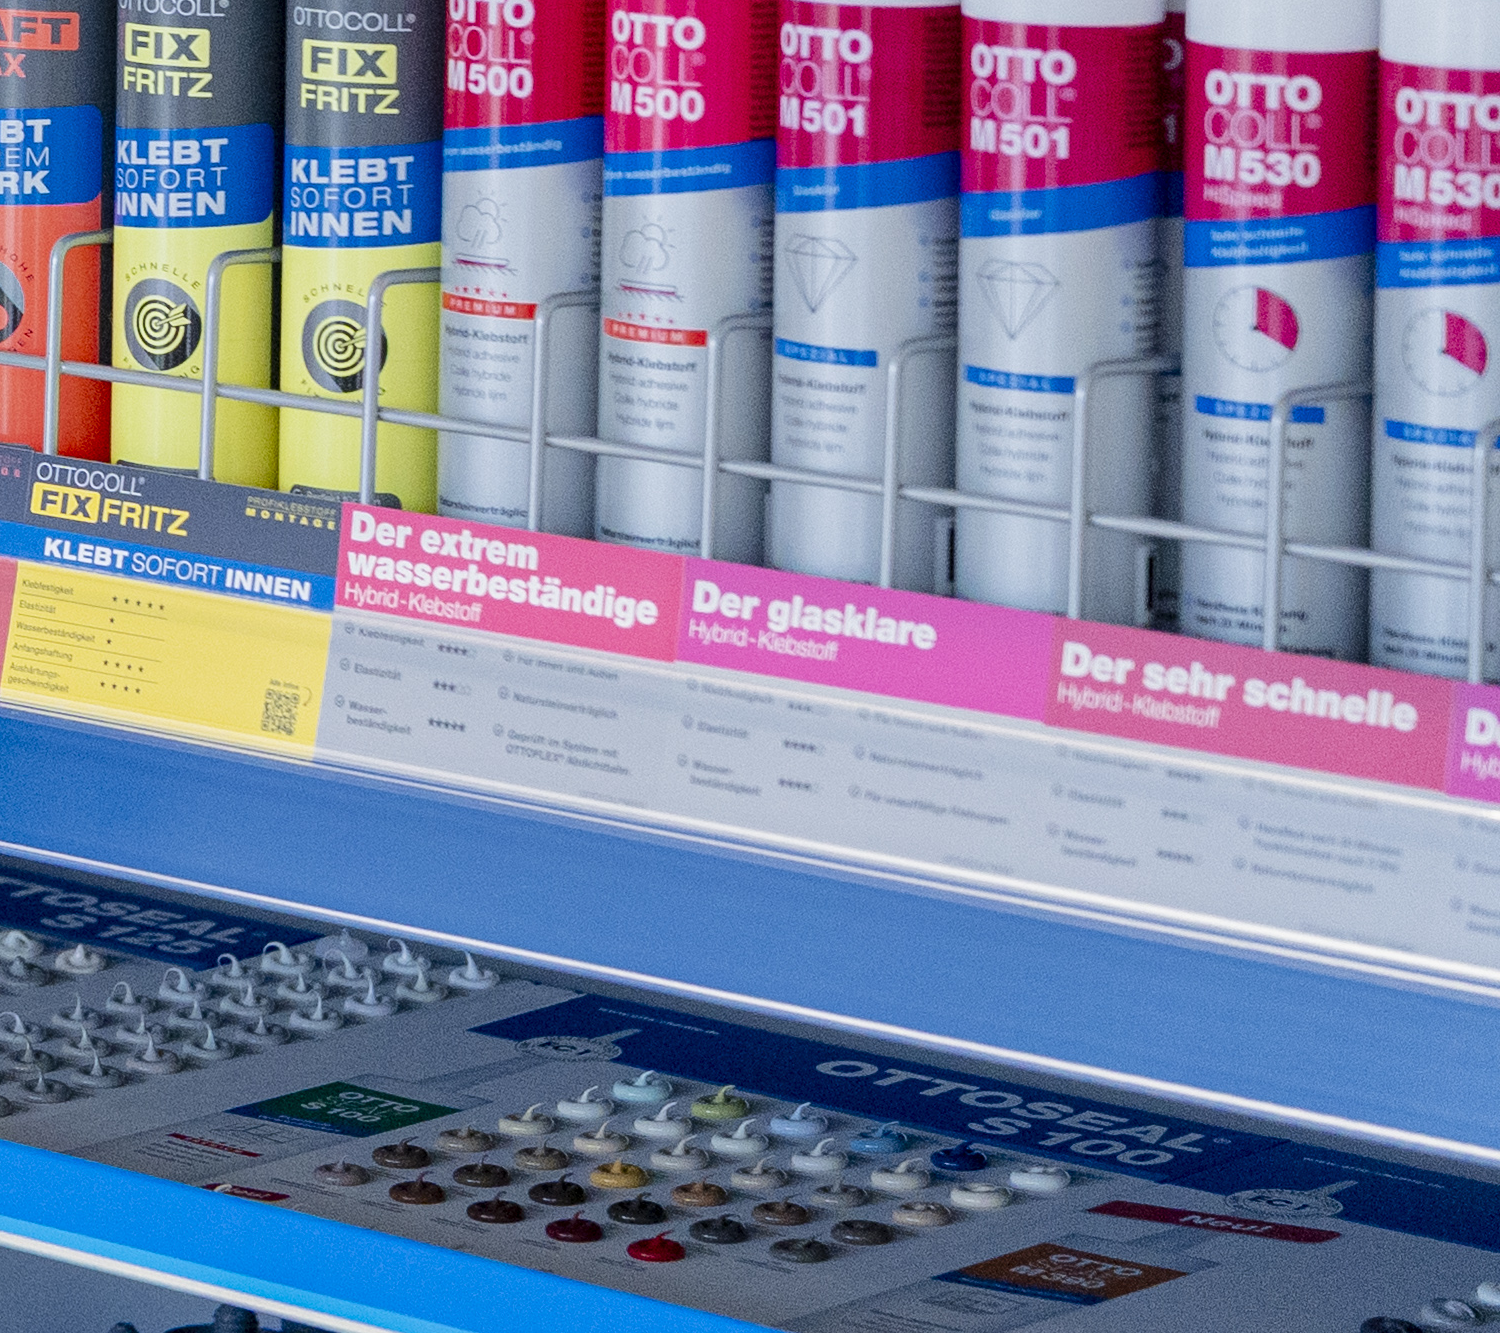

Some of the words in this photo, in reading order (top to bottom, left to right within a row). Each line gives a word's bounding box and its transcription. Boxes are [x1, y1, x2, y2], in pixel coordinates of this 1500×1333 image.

[311, 46, 388, 79] FIX
[300, 82, 399, 115] FRITZ
[1205, 70, 1322, 112] OTTO
[291, 156, 414, 184] KLEBT
[291, 185, 413, 209] SOFORT
[291, 209, 412, 237] INNEN
[41, 490, 94, 518] FIX
[102, 498, 189, 536] FRITZ
[246, 508, 336, 530] MONTAGE
[351, 511, 414, 548] Der
[420, 528, 539, 571] extrem
[44, 537, 128, 569] KLEBT
[131, 552, 222, 584] SOFORT
[225, 568, 311, 601] INNEN
[22, 580, 74, 596] Klebfestigkeit
[347, 550, 659, 628] wasserbeständige
[19, 600, 56, 614] Elastizität
[693, 580, 760, 621] Der
[766, 595, 938, 650] glasklare
[16, 620, 96, 643] Wasserbeständigkeit
[13, 642, 73, 662] Anfangshaftung
[1061, 641, 1135, 684] Der
[1142, 662, 1235, 701] sehr
[1243, 677, 1418, 731] schnelle
[97, 925, 219, 956] 125
[968, 1117, 1032, 1135] S
[1042, 1132, 1178, 1167] 100
[1178, 1212, 1274, 1234] Neu!
